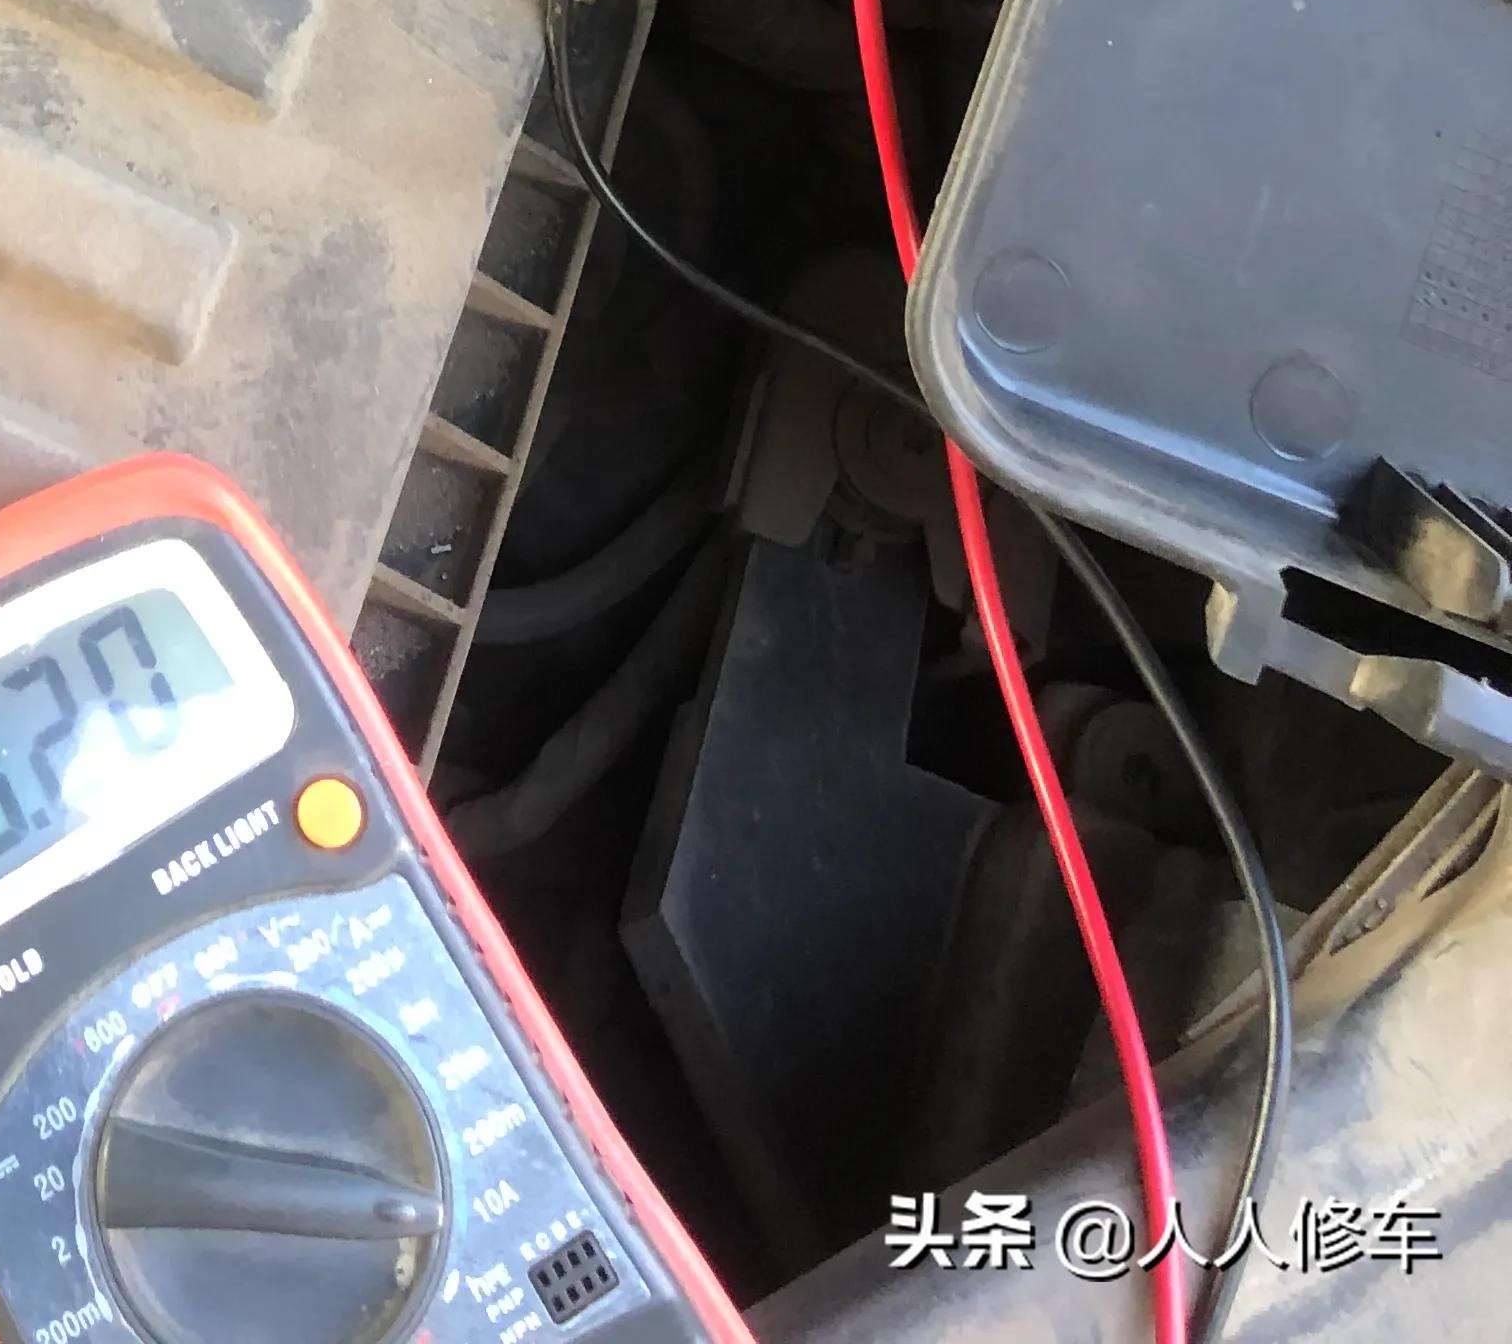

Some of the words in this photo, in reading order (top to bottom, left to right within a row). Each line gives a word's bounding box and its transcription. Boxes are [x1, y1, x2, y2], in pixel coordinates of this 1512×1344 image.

[151, 839, 218, 895] BACK
[212, 799, 281, 858] LIGHT
[83, 1010, 127, 1053] 600
[32, 1096, 77, 1141] 200
[33, 1164, 65, 1201] 20
[472, 1179, 520, 1223] 10A
[51, 1236, 72, 1265] 2
